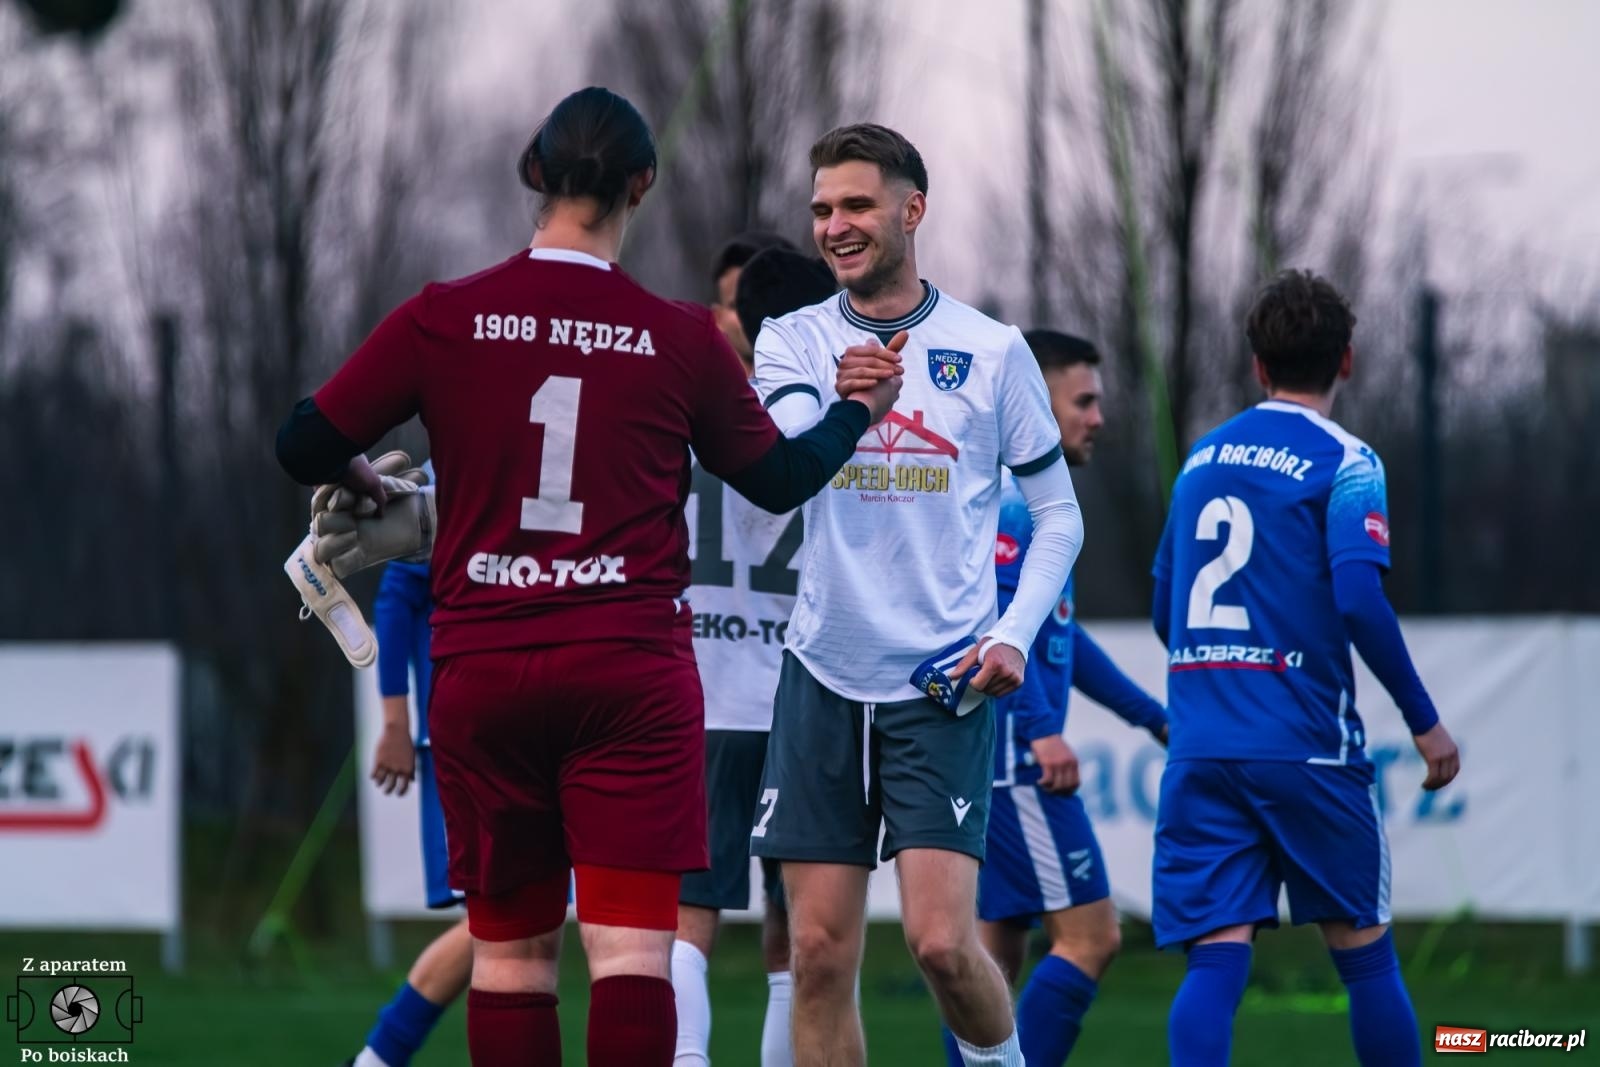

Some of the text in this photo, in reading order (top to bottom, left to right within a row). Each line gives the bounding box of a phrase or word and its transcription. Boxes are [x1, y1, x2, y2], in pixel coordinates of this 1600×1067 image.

[473, 314, 656, 356] 1908 NĘDZA
[520, 375, 584, 535] 1
[1217, 443, 1313, 481] RACIBÓRZ
[831, 463, 949, 493] SPEED-DACH
[860, 494, 915, 503] Marcin Kaczor
[467, 552, 626, 588] EKO-TOX
[1187, 496, 1254, 630] 2
[692, 613, 789, 645] EKO-TO
[751, 788, 779, 837] 7
